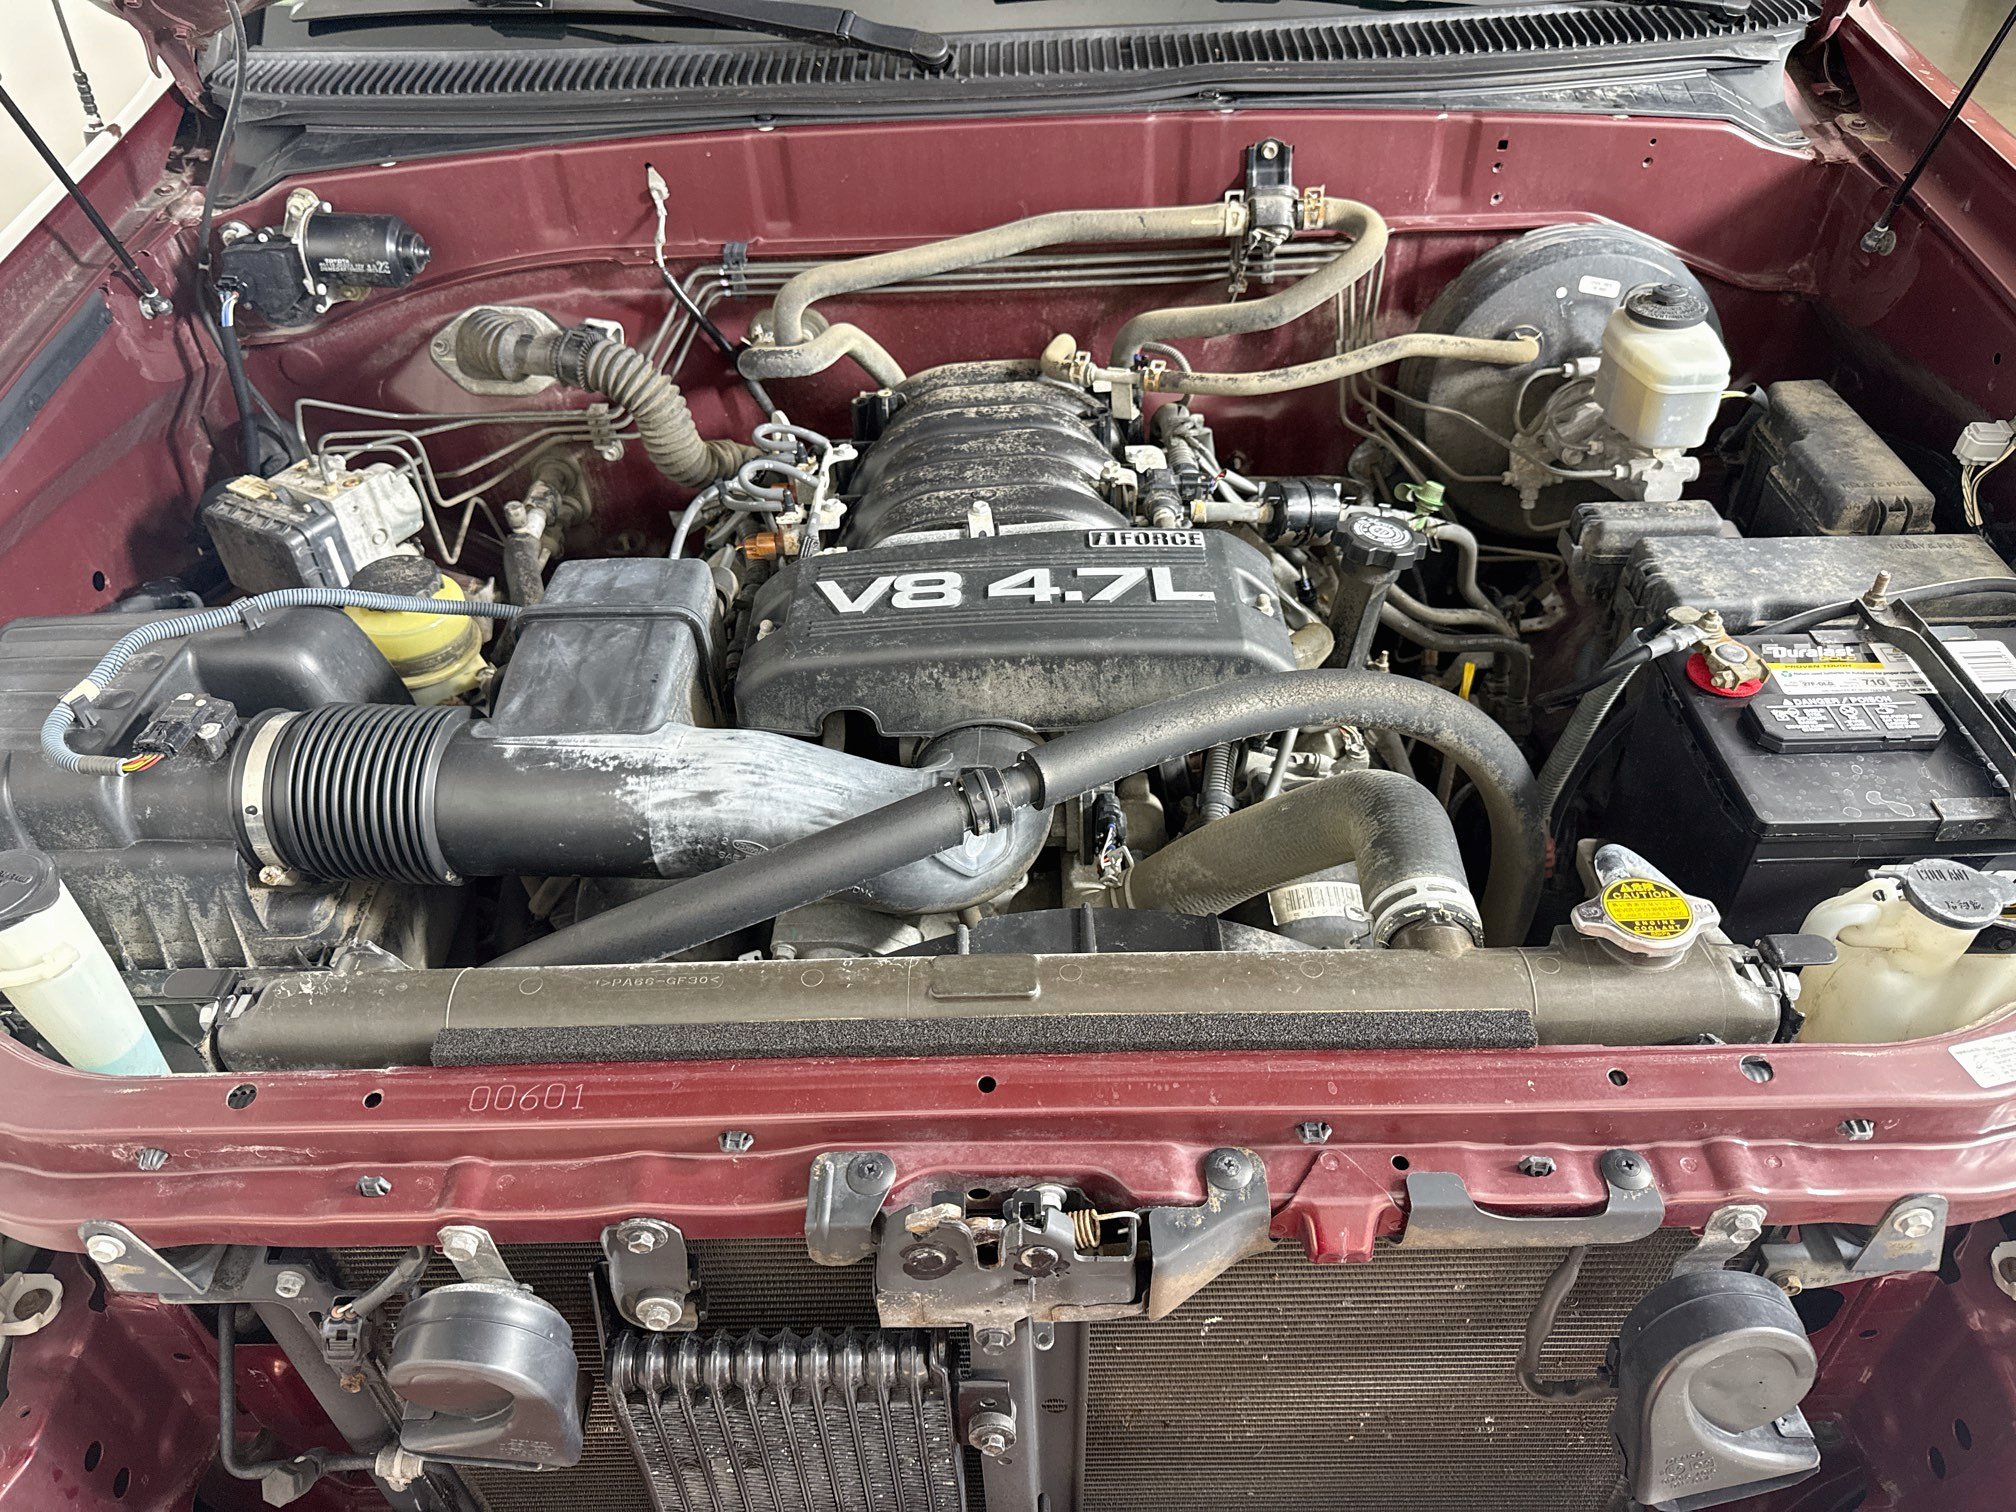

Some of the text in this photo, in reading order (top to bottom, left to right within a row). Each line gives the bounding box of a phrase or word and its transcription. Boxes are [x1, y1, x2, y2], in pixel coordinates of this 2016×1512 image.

[1120, 532, 1203, 546] FORCE
[816, 566, 1216, 613] V8 4.7L
[1765, 646, 1856, 659] Duralast
[1792, 697, 1841, 706] DANGER
[1848, 695, 1893, 704] POISON
[1612, 890, 1671, 899] CAUTION
[469, 1083, 584, 1111] 00601
